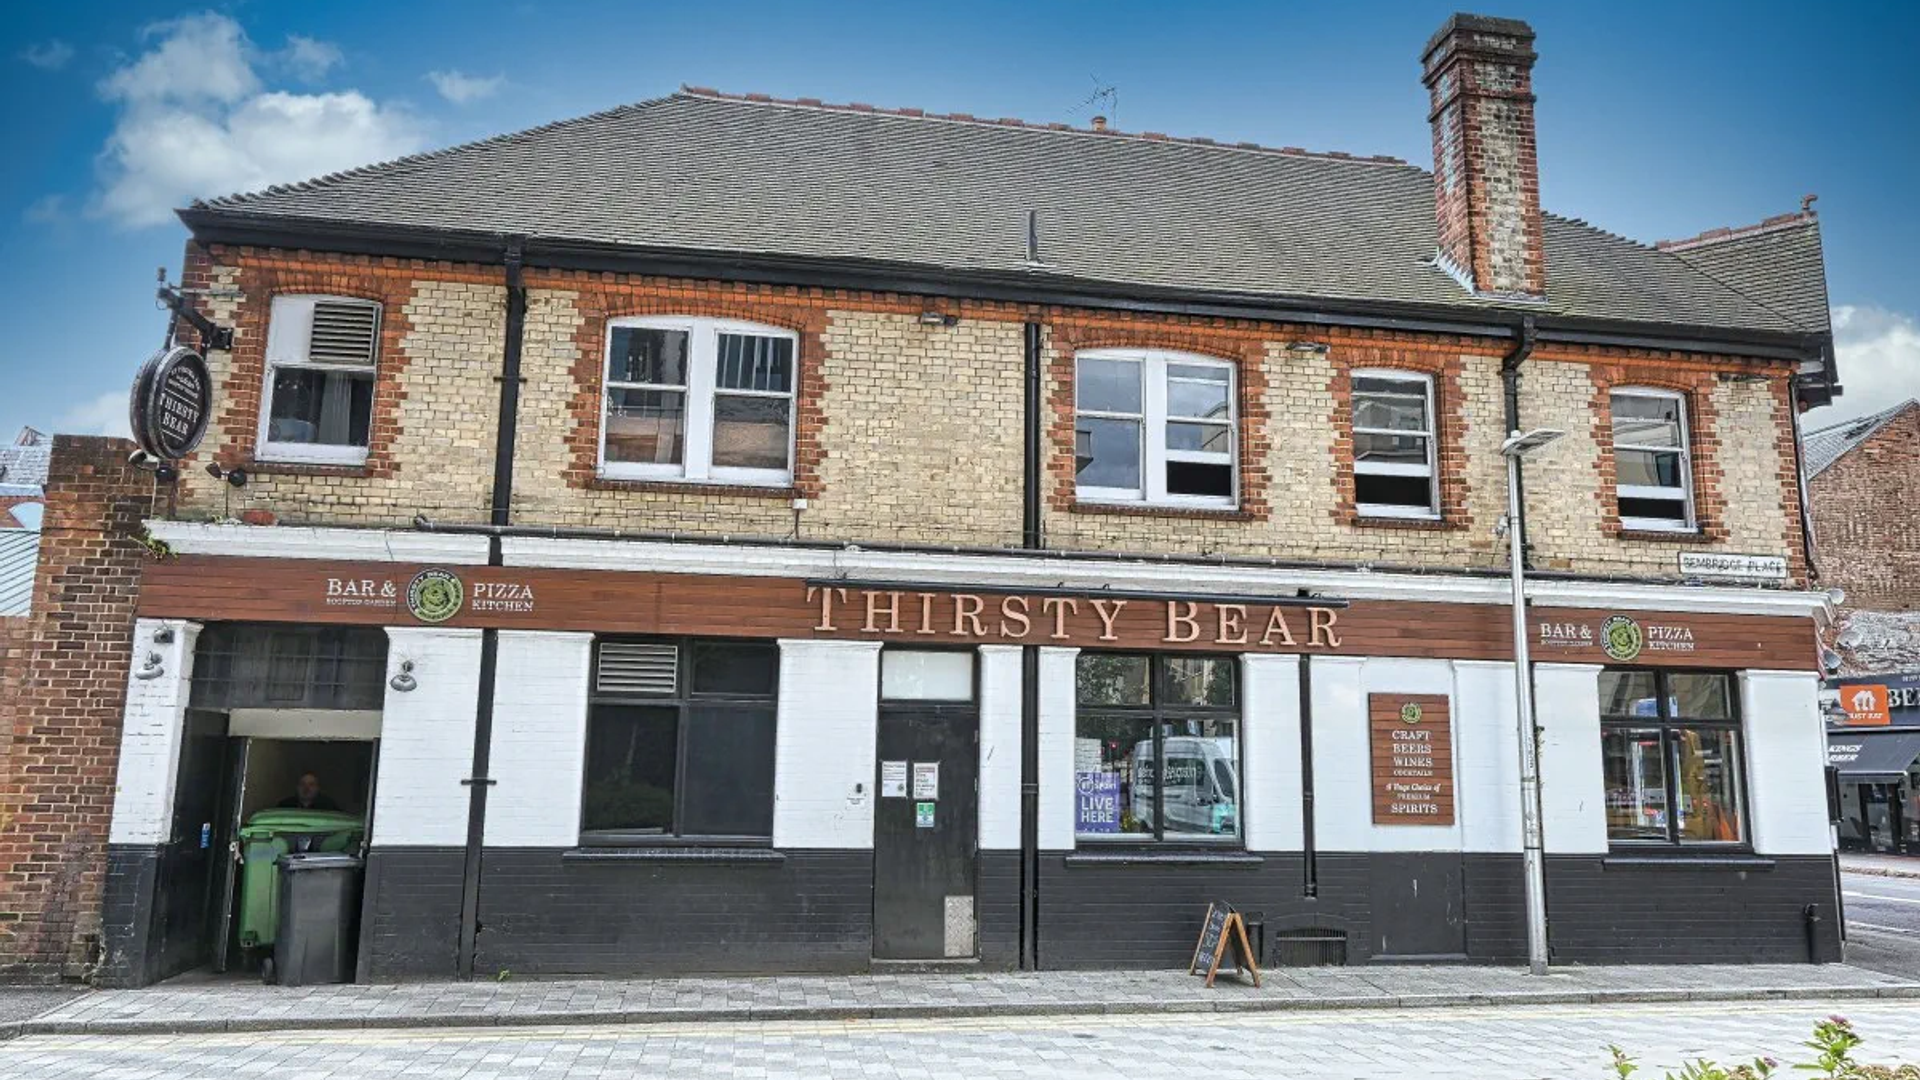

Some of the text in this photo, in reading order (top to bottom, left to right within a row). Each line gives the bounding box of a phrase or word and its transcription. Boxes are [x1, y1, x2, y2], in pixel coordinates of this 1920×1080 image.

[160, 393, 199, 423] THIRSTY
[163, 412, 188, 435] BEAR
[1747, 561, 1784, 575] PLACE
[326, 579, 397, 598] BAR &
[473, 583, 534, 599] PIZZA
[472, 600, 534, 612] KITCHEN
[807, 586, 1342, 647] THIRSTY BEAR
[1540, 623, 1576, 639] BAR
[1579, 625, 1593, 639] &
[1648, 626, 1693, 641] PIZZA
[1648, 641, 1694, 652] KITCHEN
[1391, 730, 1431, 740] CRAFT
[1393, 743, 1432, 754] BEERS
[1393, 757, 1433, 767] WINES
[1081, 796, 1114, 810] LIVE
[1390, 803, 1438, 814] SPIRITS
[1081, 810, 1114, 823] HERE
